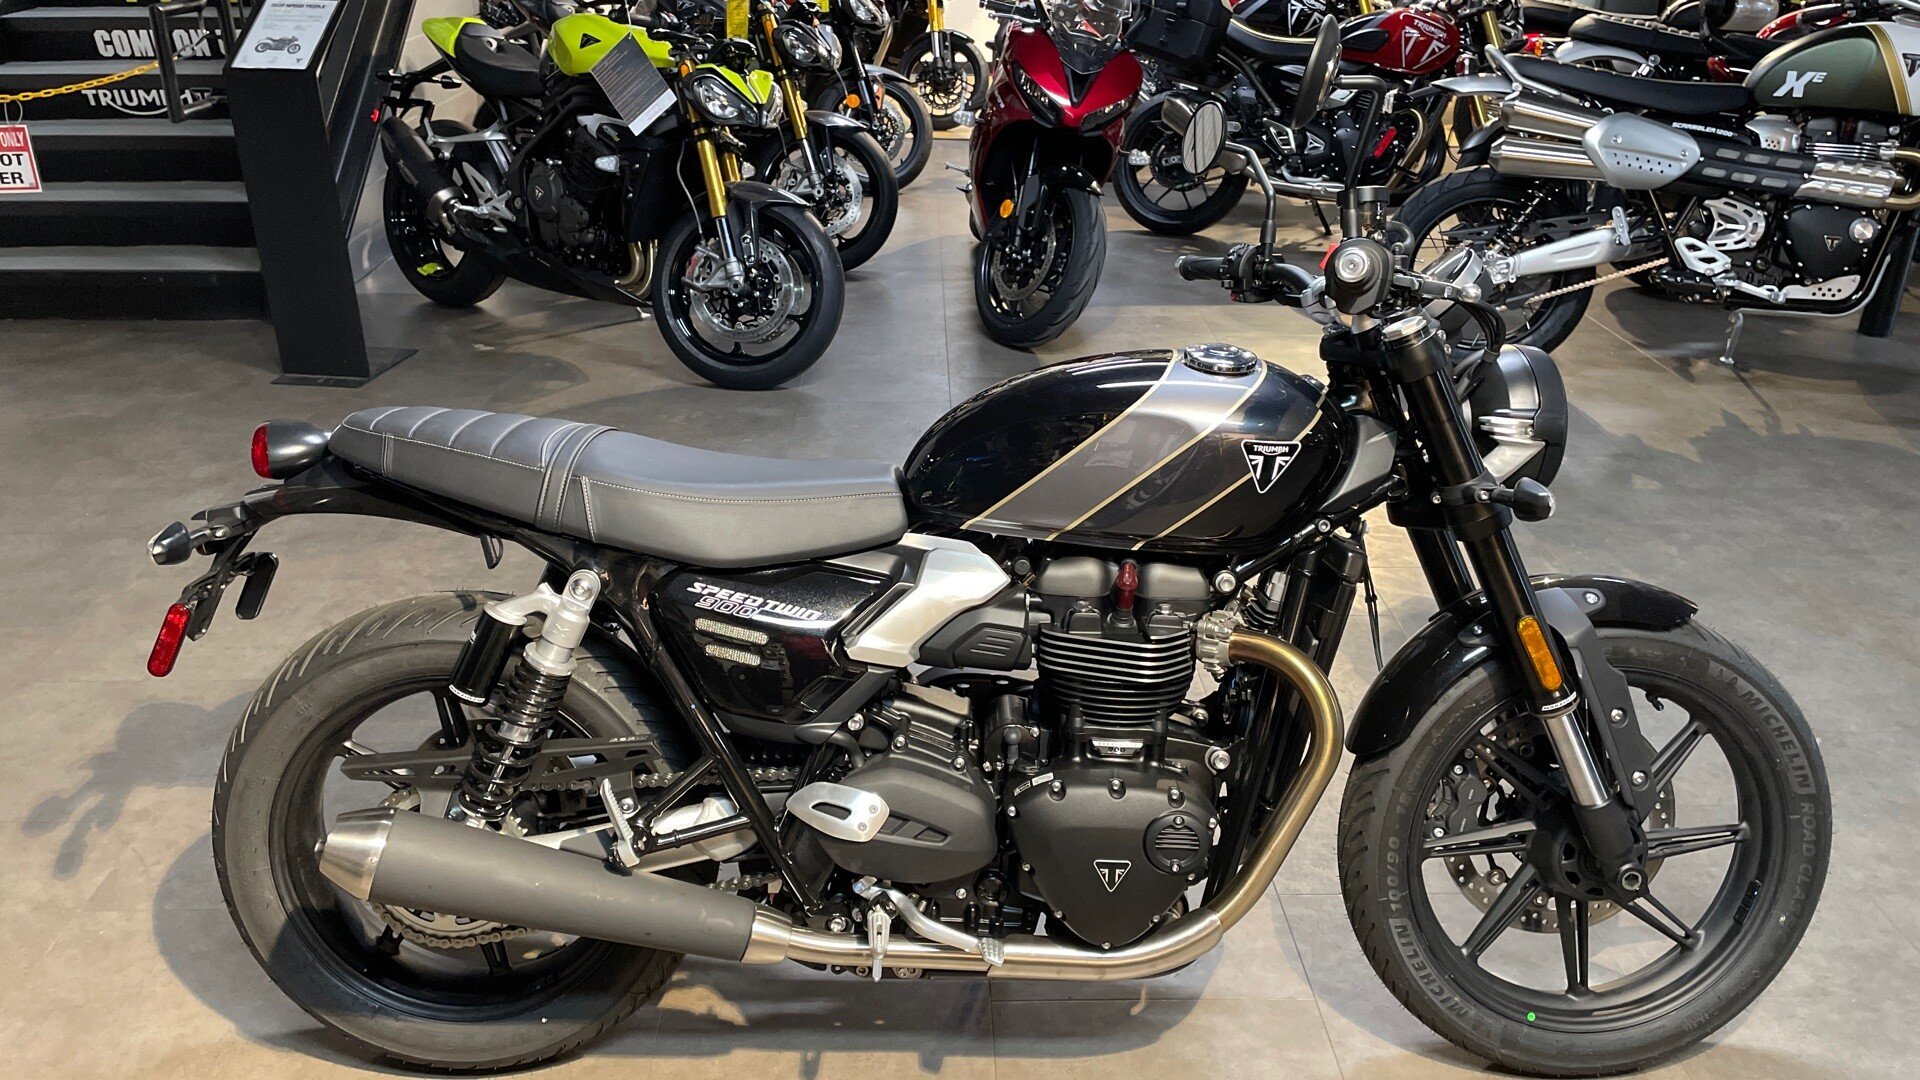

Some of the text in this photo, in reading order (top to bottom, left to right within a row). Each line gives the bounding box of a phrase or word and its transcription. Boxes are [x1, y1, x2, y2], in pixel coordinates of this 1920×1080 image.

[93, 29, 156, 57] COM
[1672, 121, 1716, 134] SCRAMBLER
[1253, 444, 1289, 455] TRIUMPH
[687, 581, 764, 609] SPEED
[694, 595, 758, 619] 900
[1738, 689, 1813, 790] MICHELIN
[1800, 802, 1817, 857] ROAD
[1394, 923, 1470, 1019] MICHELIN
